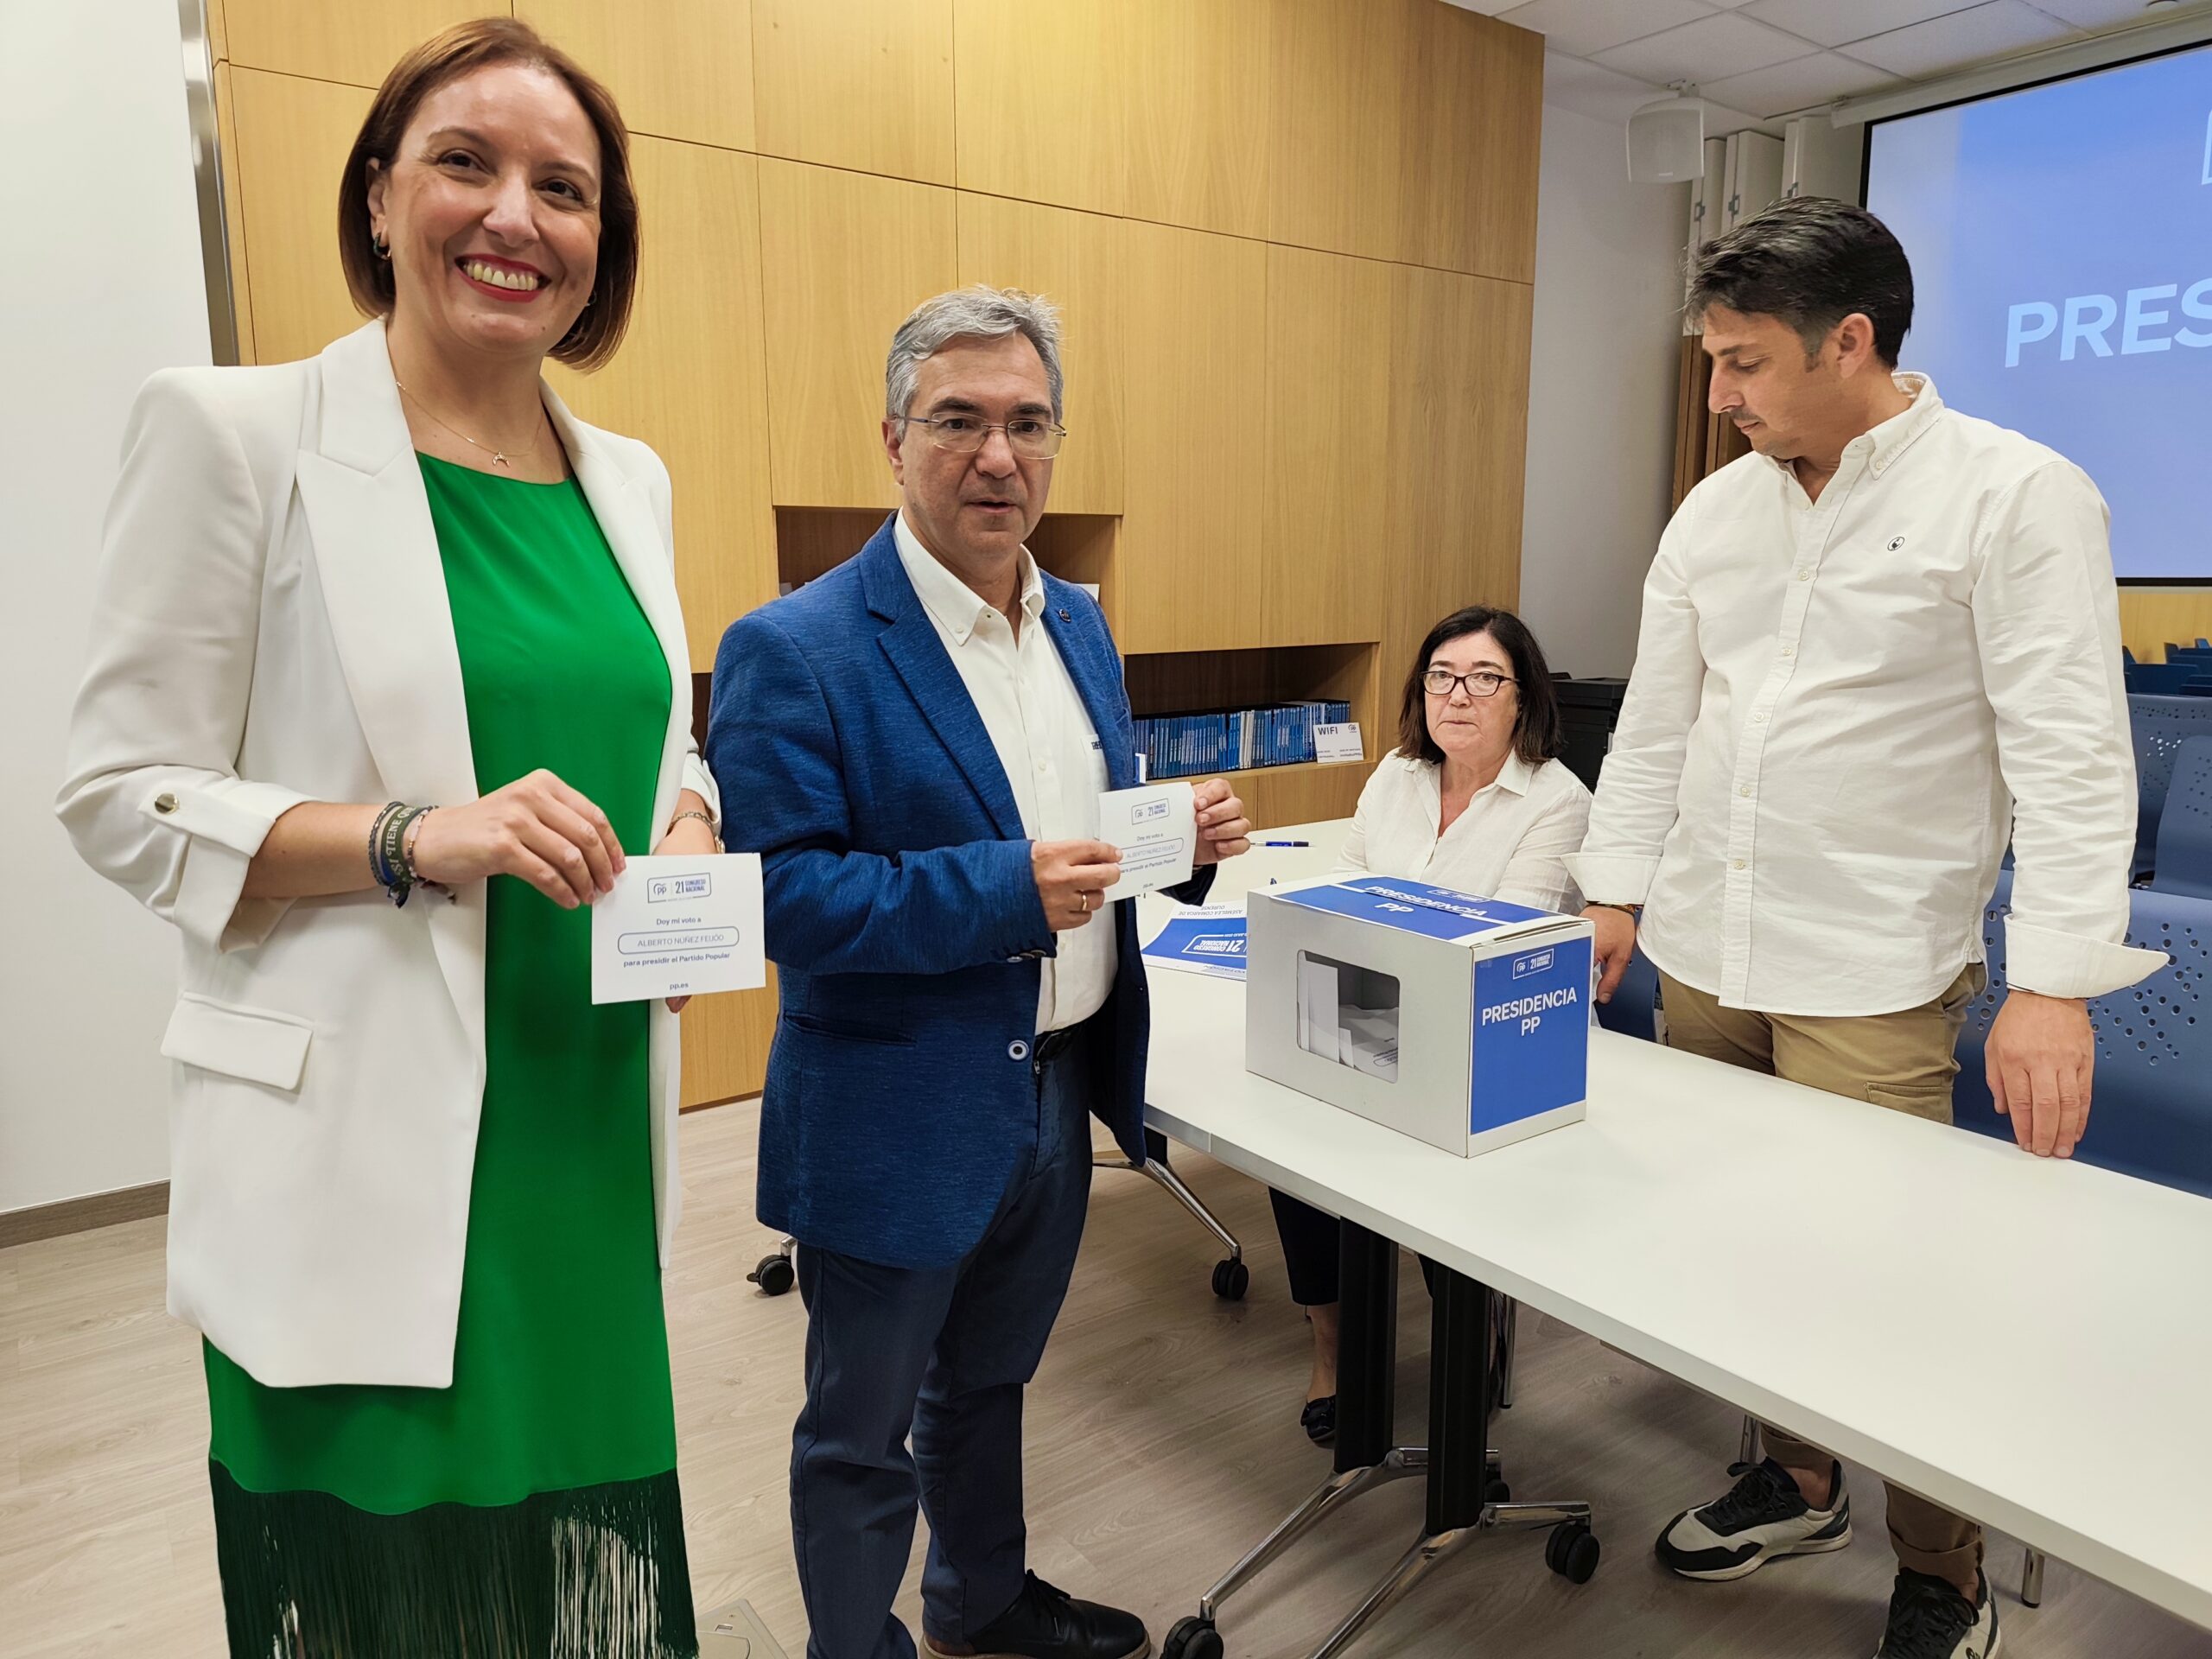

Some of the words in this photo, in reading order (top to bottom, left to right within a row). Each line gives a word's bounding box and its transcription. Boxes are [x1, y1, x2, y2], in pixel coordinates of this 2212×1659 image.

[2005, 276, 2212, 368] PRES
[1318, 727, 1338, 735] WIFI
[385, 819, 403, 856] TIENE
[676, 880, 684, 894] 21
[1365, 886, 1488, 916] PRESIDENCIA
[1375, 902, 1414, 912] PP
[638, 938, 673, 947] ALBERTO
[1225, 940, 1245, 952] 21
[642, 957, 670, 966] presidir
[679, 954, 704, 963] Partido
[705, 952, 730, 961] Popular
[1530, 958, 1536, 969] 21
[1482, 987, 1577, 1026] PRESIDENCIA
[1522, 1016, 1541, 1036] PP
